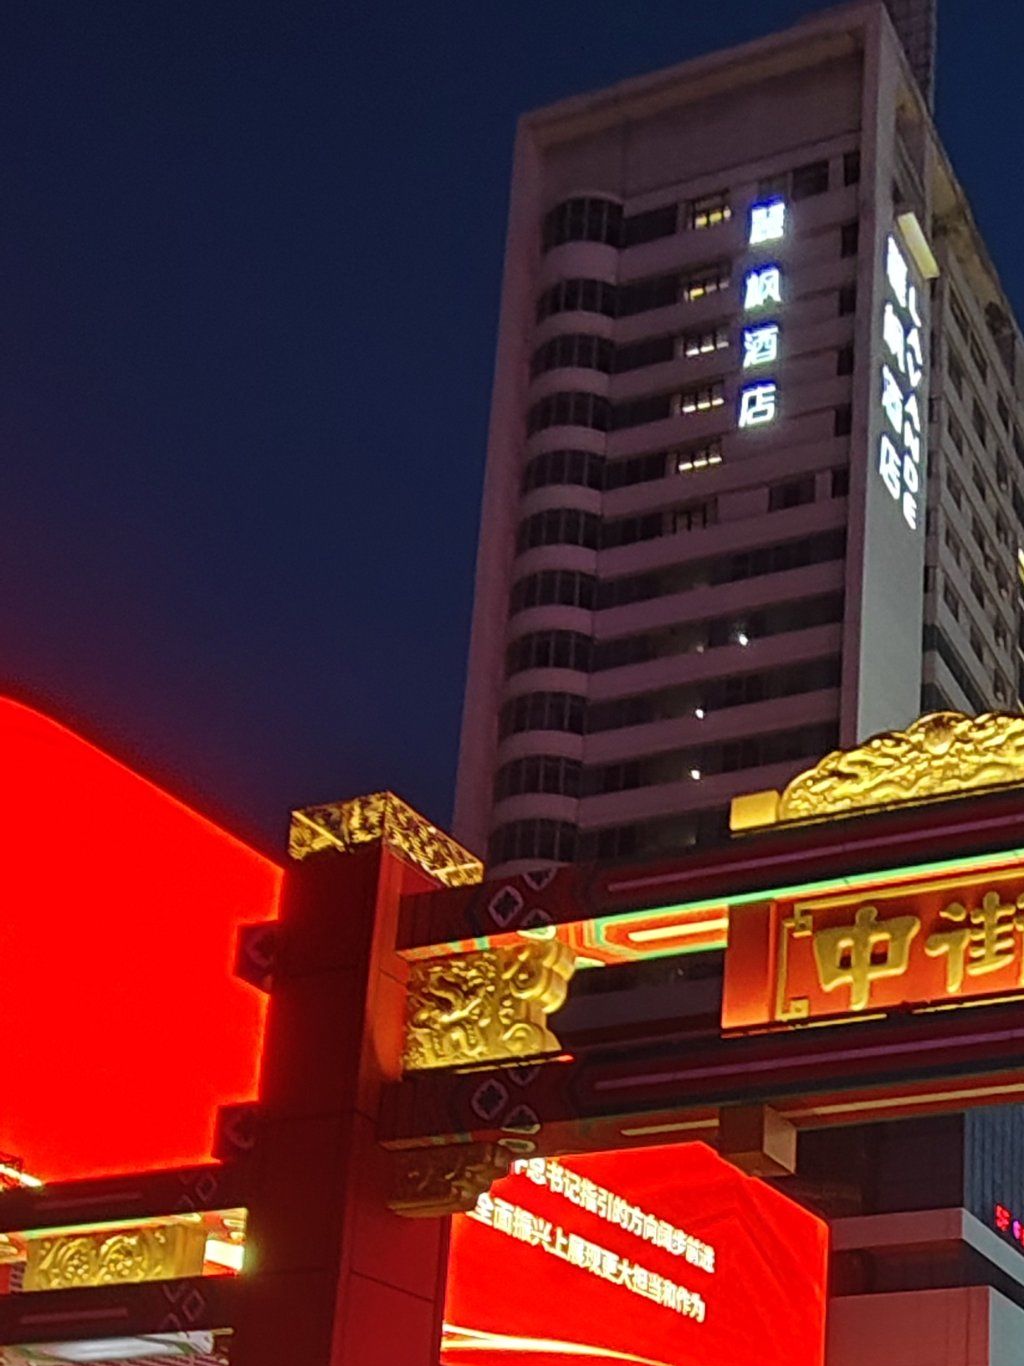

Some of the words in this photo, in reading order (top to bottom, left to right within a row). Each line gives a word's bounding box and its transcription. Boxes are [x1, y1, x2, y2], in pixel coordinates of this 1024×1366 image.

[513, 1156, 716, 1274] 总书记指引的方向阔步前进
